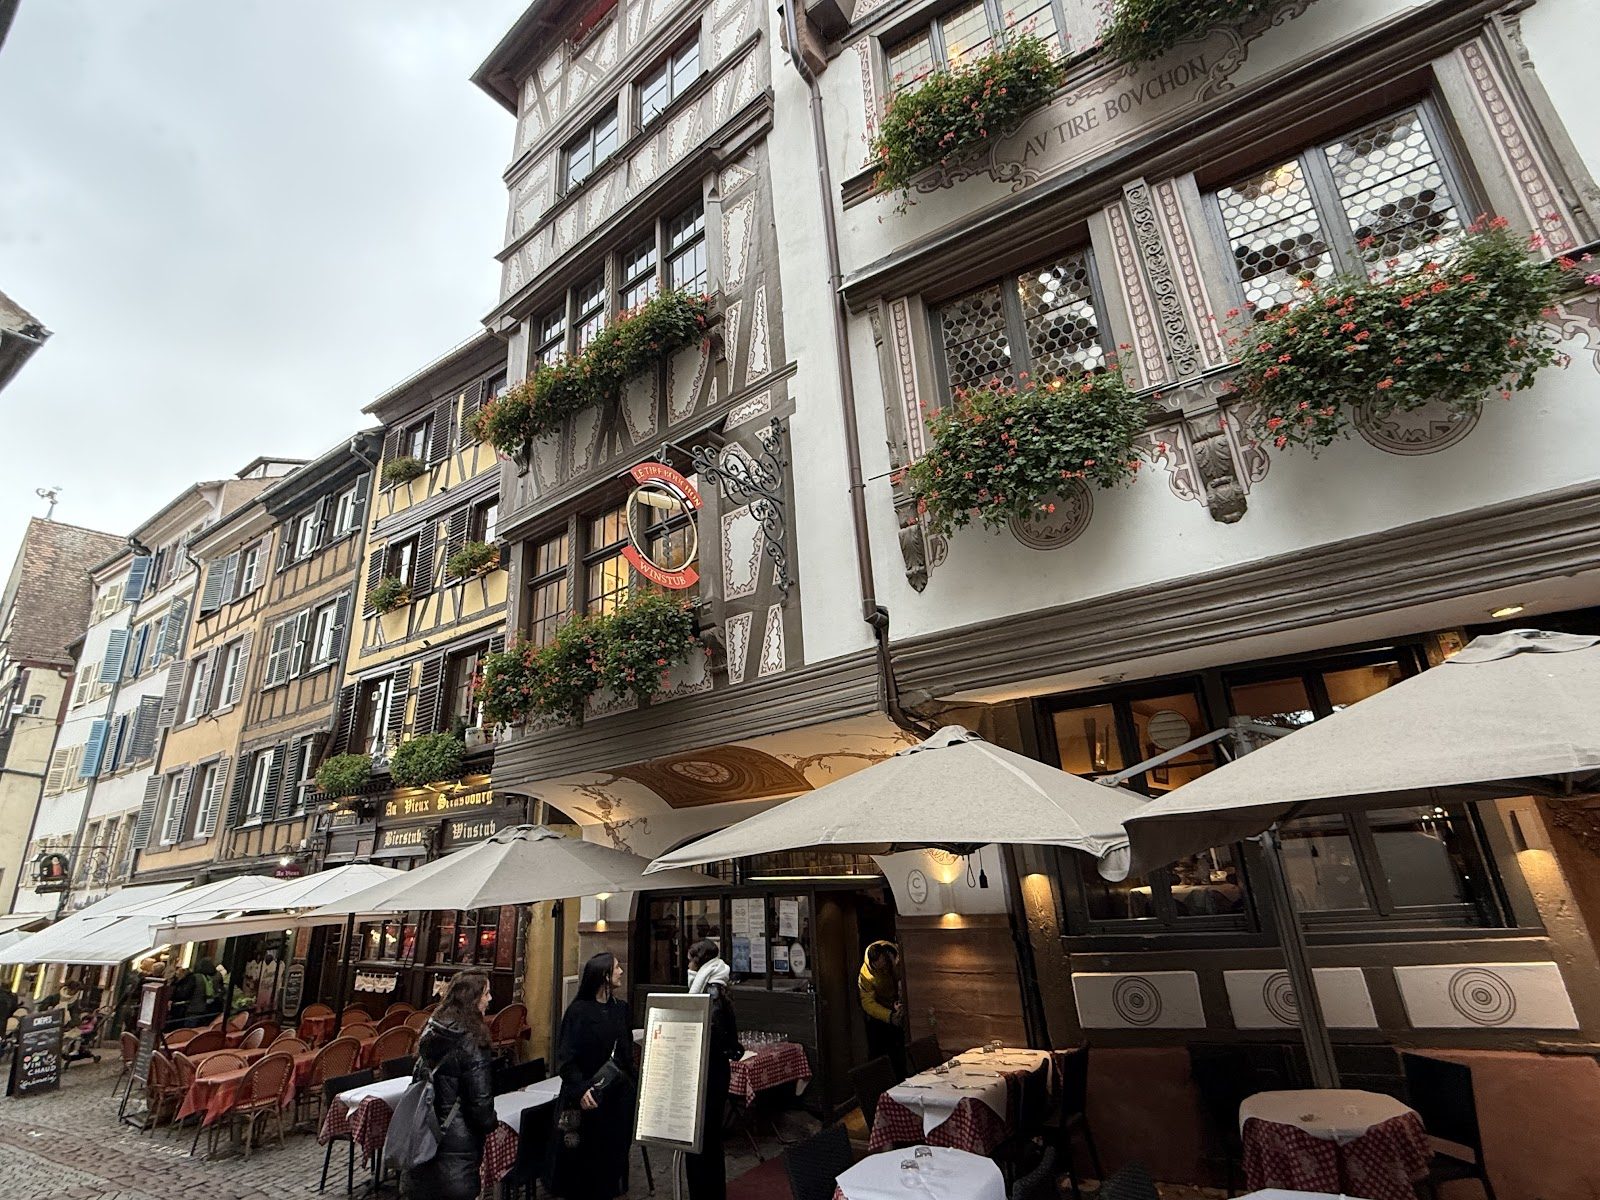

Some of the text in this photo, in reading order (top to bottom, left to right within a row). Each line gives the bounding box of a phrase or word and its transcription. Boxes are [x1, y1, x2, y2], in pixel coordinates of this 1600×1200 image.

[1022, 132, 1048, 163] AV
[1053, 108, 1099, 145] TIRE
[634, 468, 645, 480] LE
[645, 466, 662, 475] TIRE
[640, 561, 686, 585] WINSTUB
[385, 801, 397, 816] Au
[404, 798, 430, 815] Vieux
[384, 819, 496, 848] Bierstub Winstub
[23, 1060, 41, 1070] VIN
[28, 1065, 56, 1076] CHAUD
